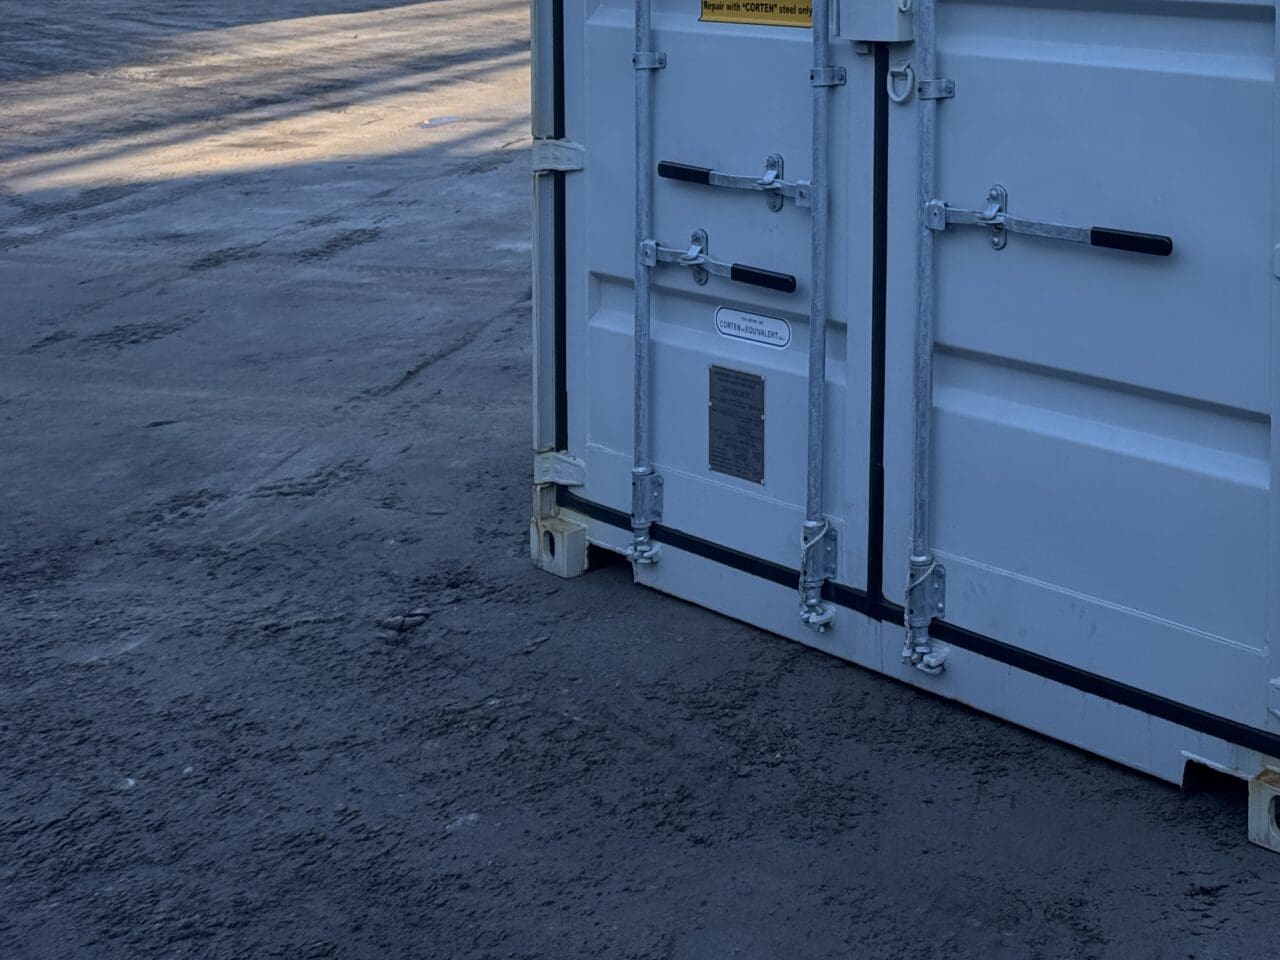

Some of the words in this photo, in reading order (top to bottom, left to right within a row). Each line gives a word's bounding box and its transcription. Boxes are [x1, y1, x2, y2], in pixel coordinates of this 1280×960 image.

[703, 0, 725, 12] Repair
[726, 1, 741, 11] with
[779, 5, 796, 14] steel
[719, 319, 741, 332] CORTEN
[745, 325, 778, 340] EQUIVALENT
